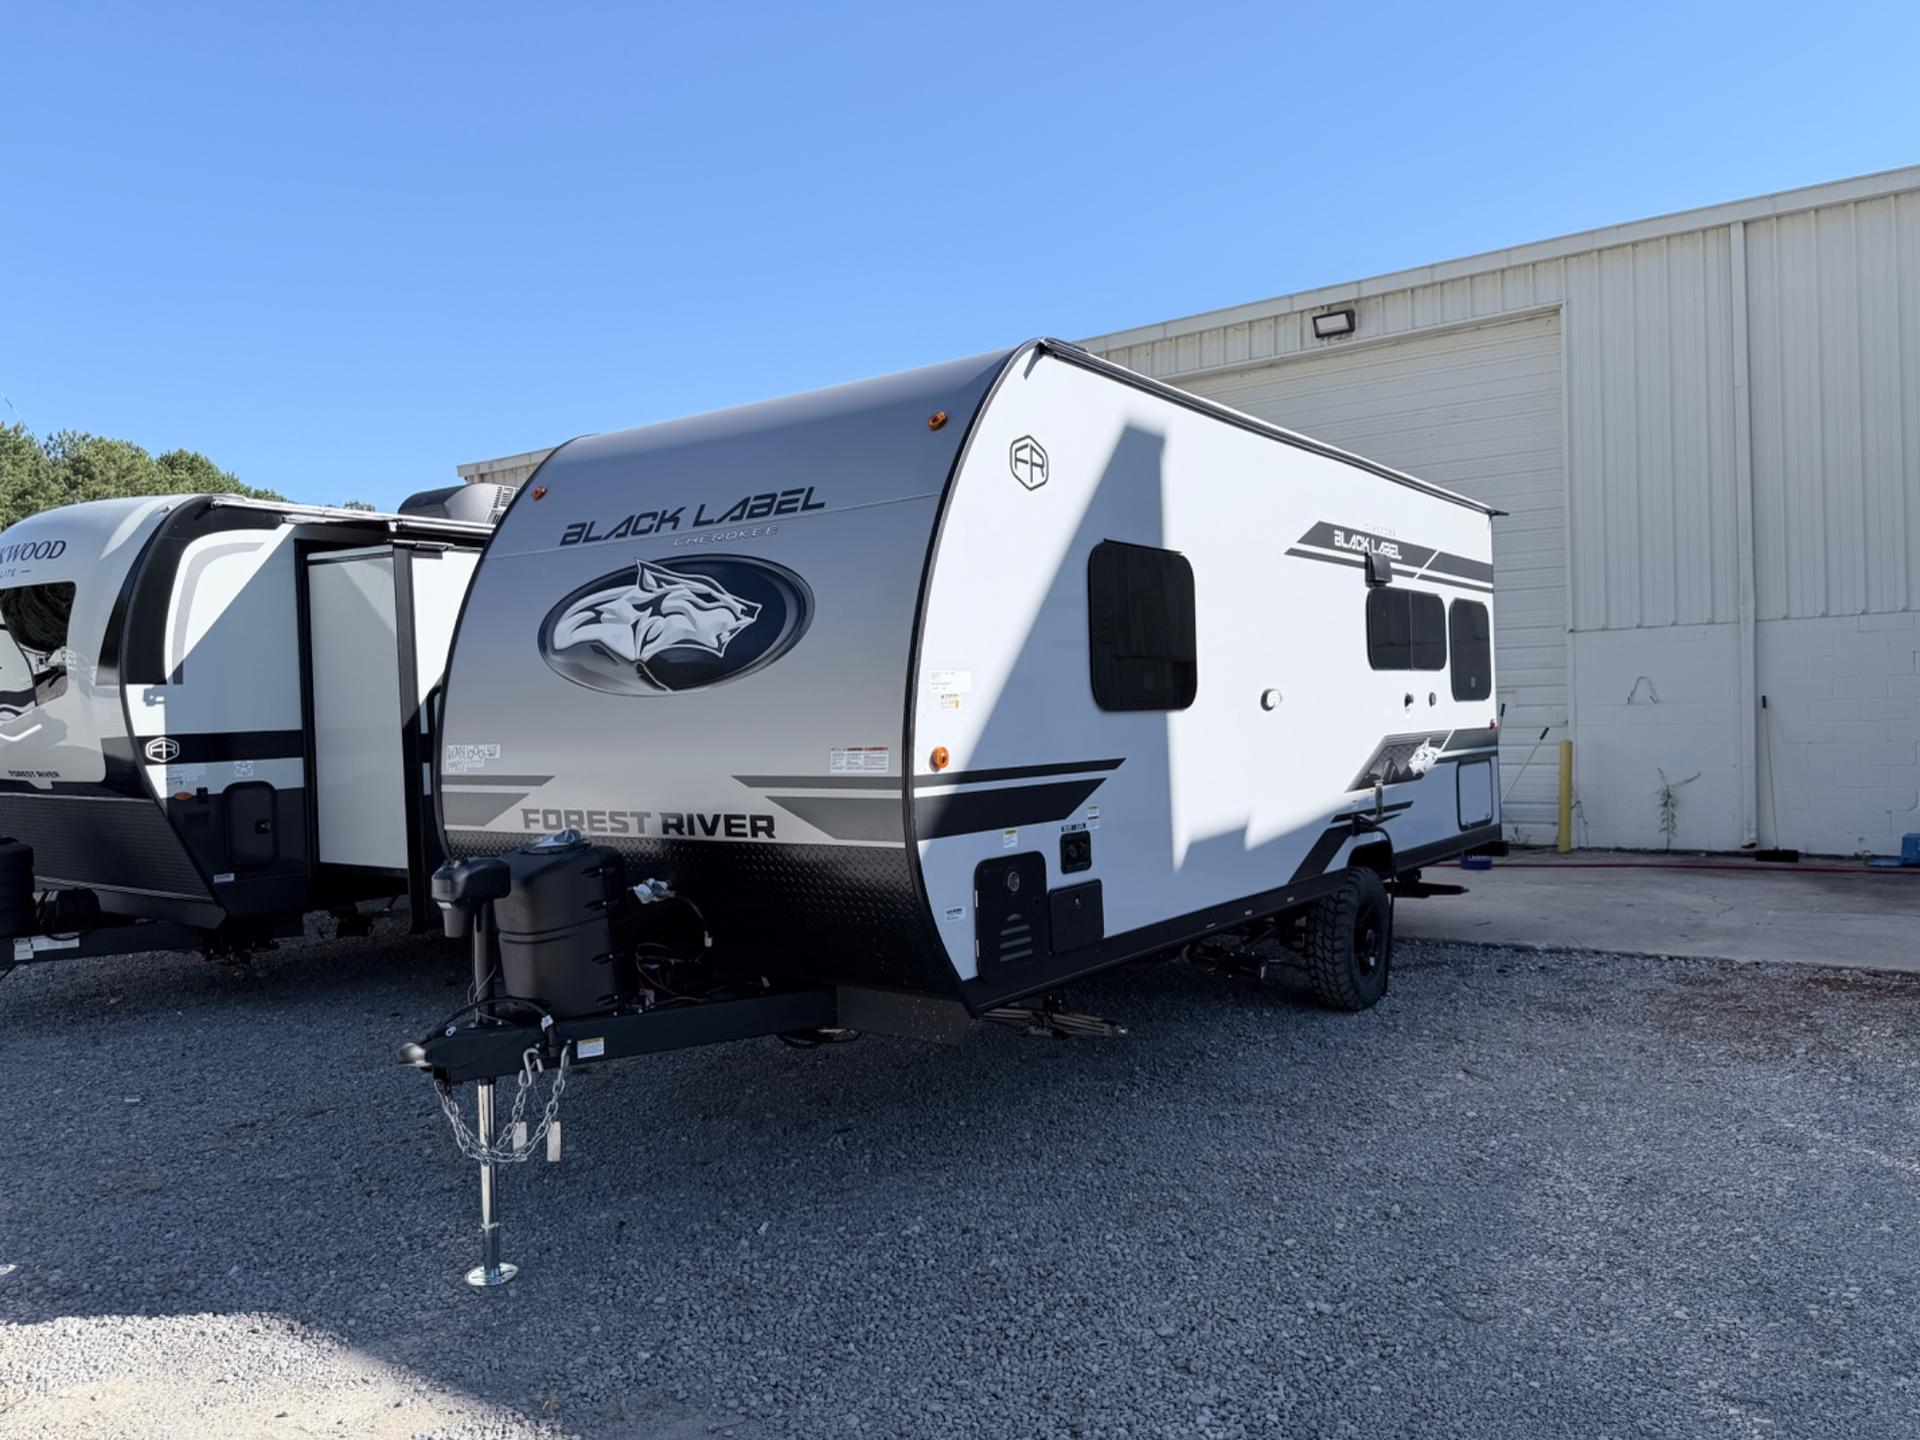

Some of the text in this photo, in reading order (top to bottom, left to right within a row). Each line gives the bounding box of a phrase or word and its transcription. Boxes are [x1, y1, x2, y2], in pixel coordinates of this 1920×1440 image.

[559, 486, 826, 546] BLACK LABEL
[672, 525, 779, 547] CHEROKEE
[1333, 529, 1371, 557] BLACK
[1371, 538, 1402, 560] LABEL
[520, 808, 777, 839] FOREST RIVER
